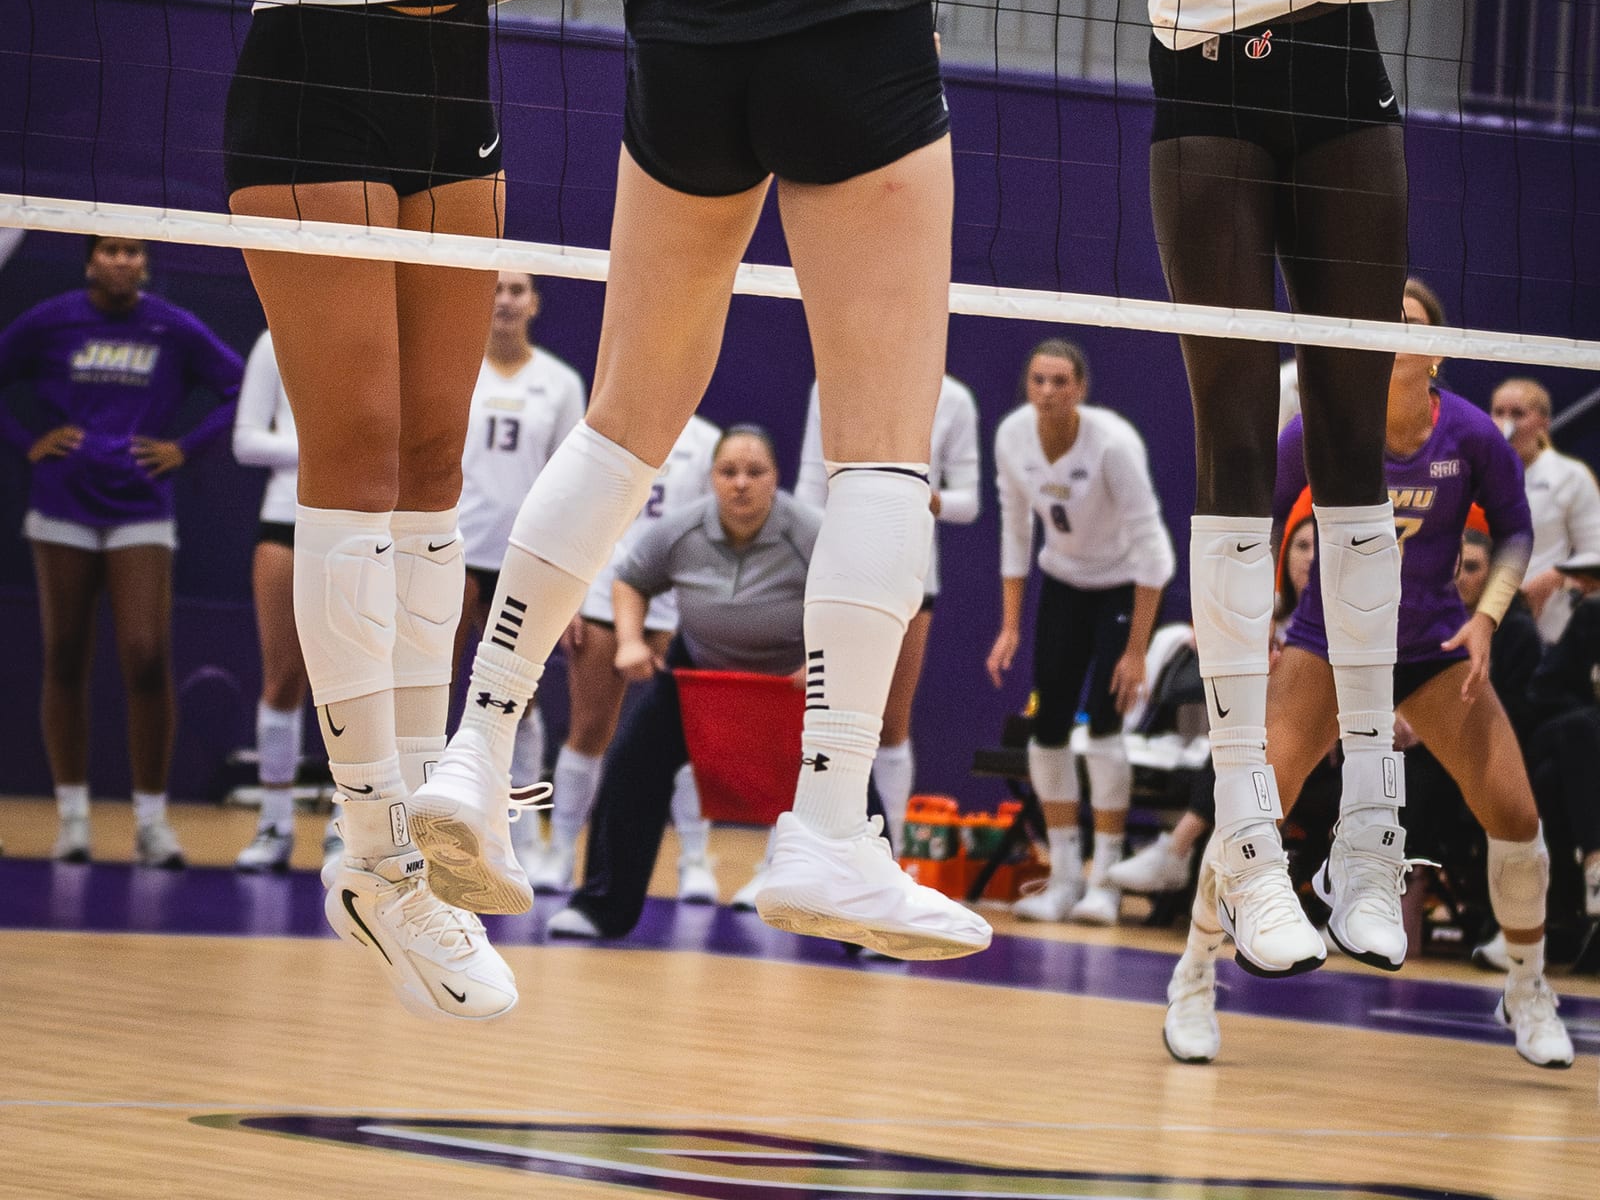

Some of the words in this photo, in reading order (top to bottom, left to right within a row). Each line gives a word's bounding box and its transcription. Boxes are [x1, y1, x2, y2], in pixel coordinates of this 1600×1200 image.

[72, 341, 158, 374] JMU
[487, 414, 521, 453] 13
[1387, 486, 1437, 511] MU
[405, 858, 425, 874] NIKE
